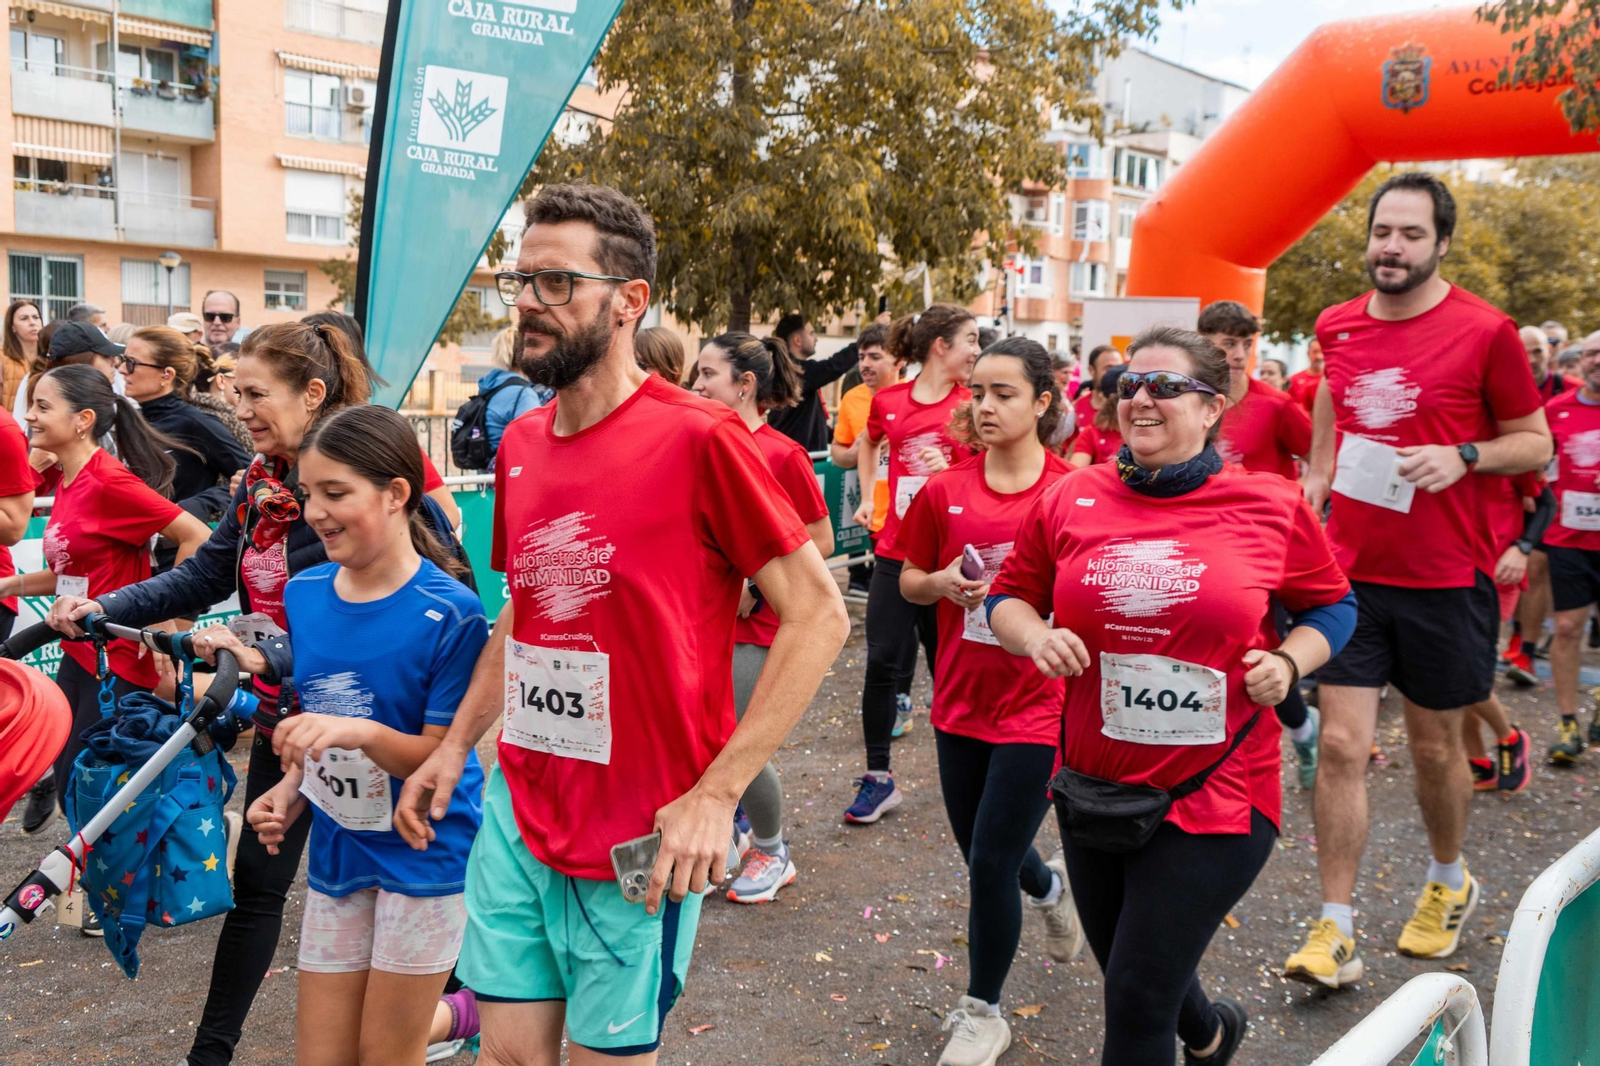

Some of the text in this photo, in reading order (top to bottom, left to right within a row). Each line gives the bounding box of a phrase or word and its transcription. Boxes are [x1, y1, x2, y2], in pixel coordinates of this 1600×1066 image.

[448, 0, 574, 35] CAJA RURAL
[471, 22, 544, 46] GRANADA
[407, 67, 425, 143] fundación
[407, 145, 498, 172] CAJA RURAL
[421, 162, 476, 180] GRANADA
[513, 547, 611, 570] kilómetros de
[1087, 558, 1201, 578] kilómetros de
[514, 568, 611, 589] HUMANIDAD
[1084, 573, 1200, 592] HUMANIDAD
[1104, 623, 1171, 636] #CarreraCruzRoja
[520, 681, 585, 718] 1403
[1121, 685, 1203, 712] 1404
[65, 902, 74, 914] 4
